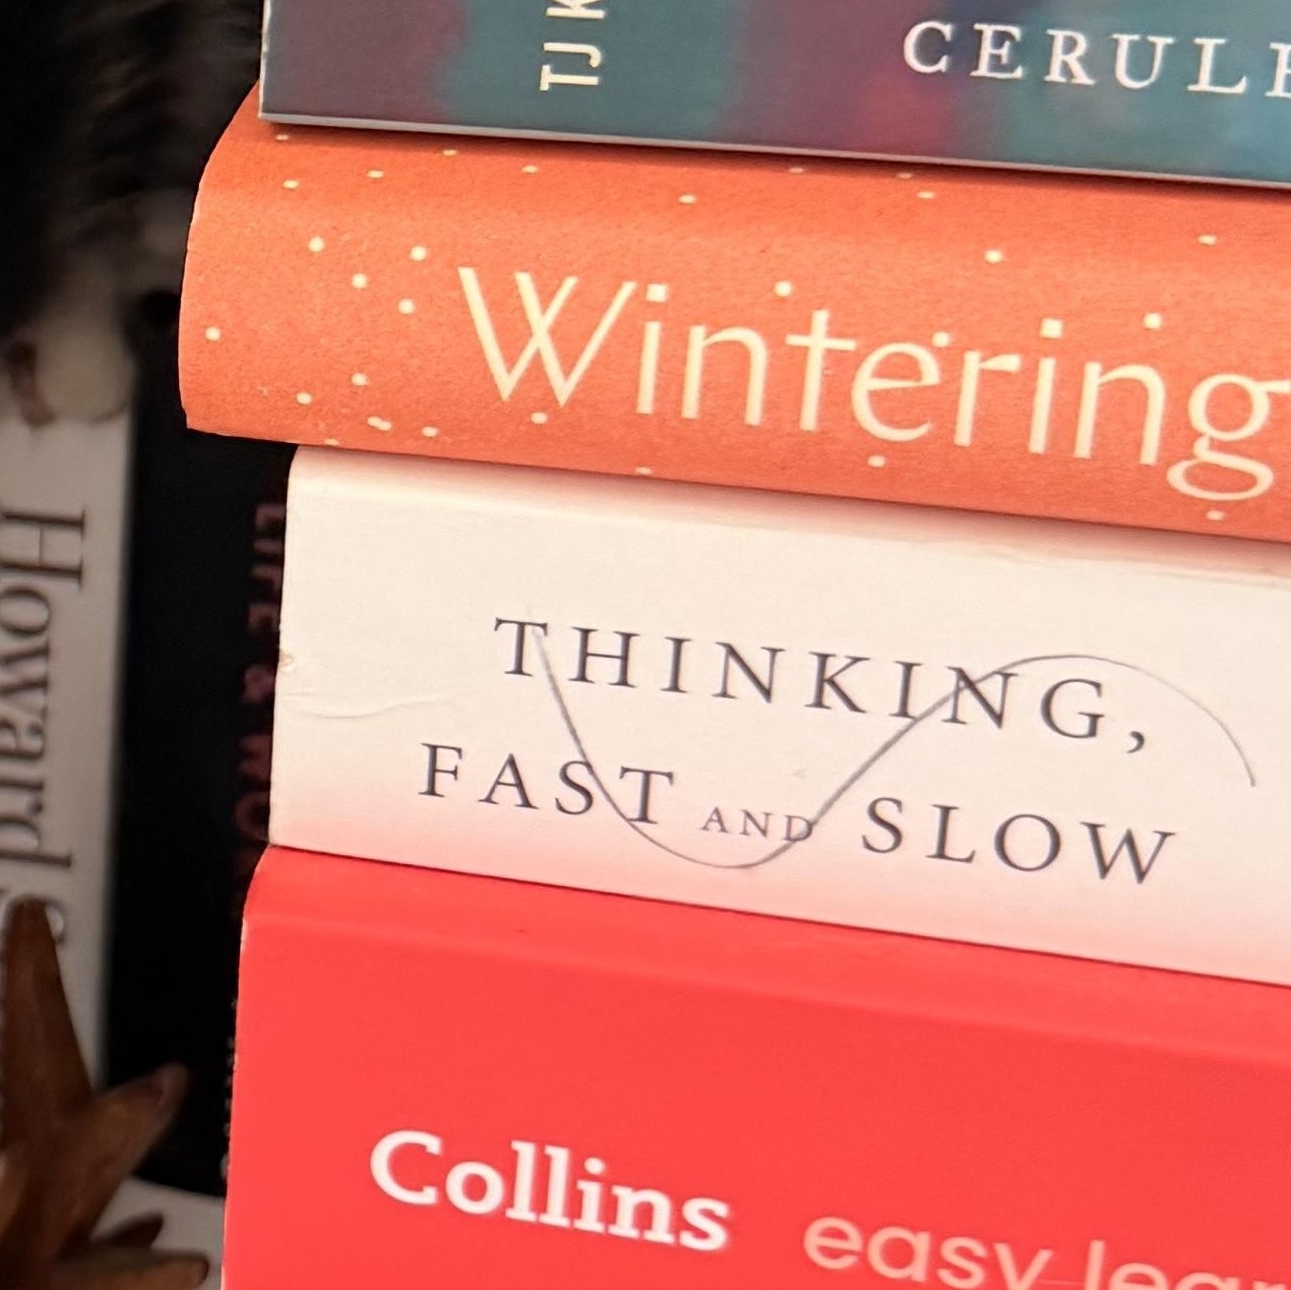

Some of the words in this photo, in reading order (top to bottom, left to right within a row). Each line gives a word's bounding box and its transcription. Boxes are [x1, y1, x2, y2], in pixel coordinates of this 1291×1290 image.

[539, 41, 601, 93] TJ
[457, 266, 1291, 502] Wintering
[493, 617, 1149, 756] THINKING,
[418, 741, 677, 825] FAST
[700, 807, 815, 844] AND
[862, 796, 1177, 886] SLOW
[370, 1130, 731, 1252] Collins
